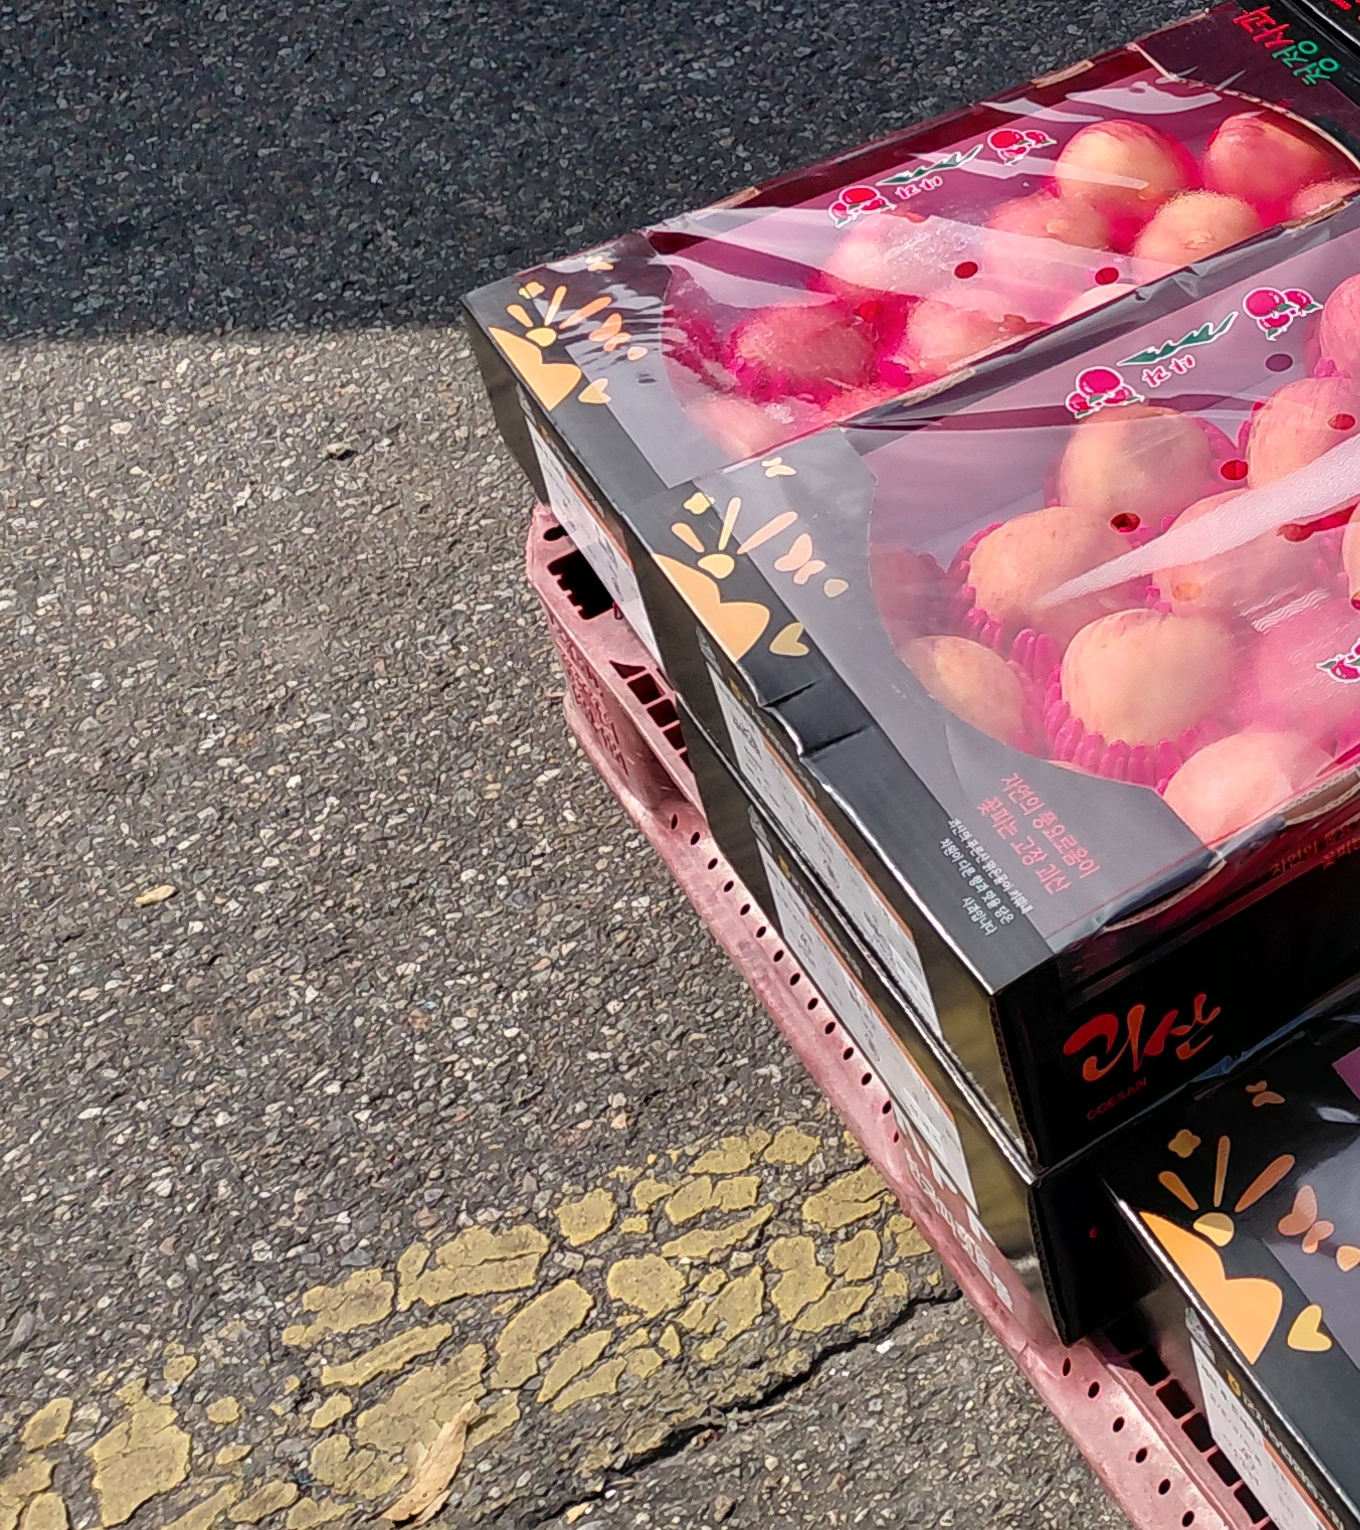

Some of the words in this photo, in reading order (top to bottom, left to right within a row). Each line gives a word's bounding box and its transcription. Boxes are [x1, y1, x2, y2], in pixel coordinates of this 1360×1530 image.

[1232, 5, 1295, 50] 사과
[1271, 40, 1341, 86] 청정
[976, 796, 1018, 840] 꽃피는
[1010, 835, 1049, 866] 고장
[1035, 863, 1072, 895] 괴산
[1001, 772, 1045, 816] 자연의
[1032, 810, 1101, 879] 풍요로움이
[1062, 990, 1223, 1084] 괴산
